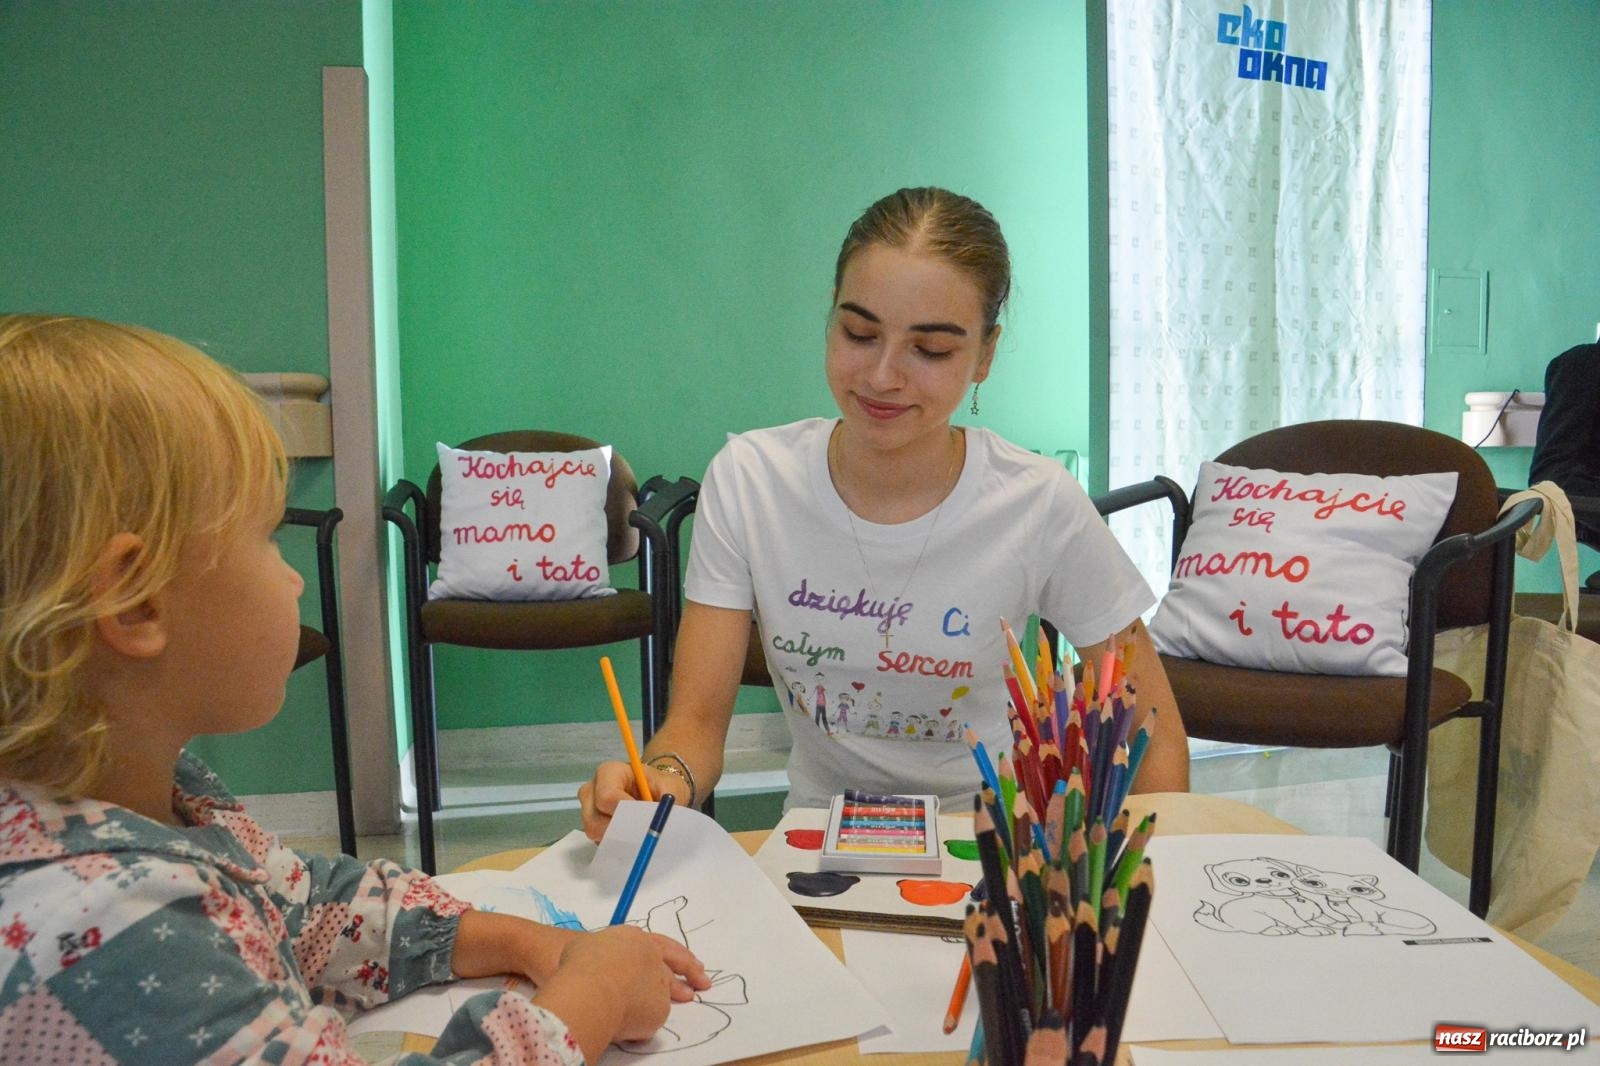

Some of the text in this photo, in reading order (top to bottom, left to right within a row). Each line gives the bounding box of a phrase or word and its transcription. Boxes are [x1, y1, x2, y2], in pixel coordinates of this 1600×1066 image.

[457, 455, 597, 489] Kochajcie
[490, 486, 525, 510] się
[1211, 476, 1407, 521] Kochajcie
[453, 523, 556, 545] mamo
[1228, 507, 1275, 533] się
[506, 554, 600, 582] i tato
[1176, 551, 1310, 583] mamo
[788, 578, 971, 637] dziękuję Ci
[1229, 601, 1375, 645] i tato
[772, 631, 975, 679] całym sercem
